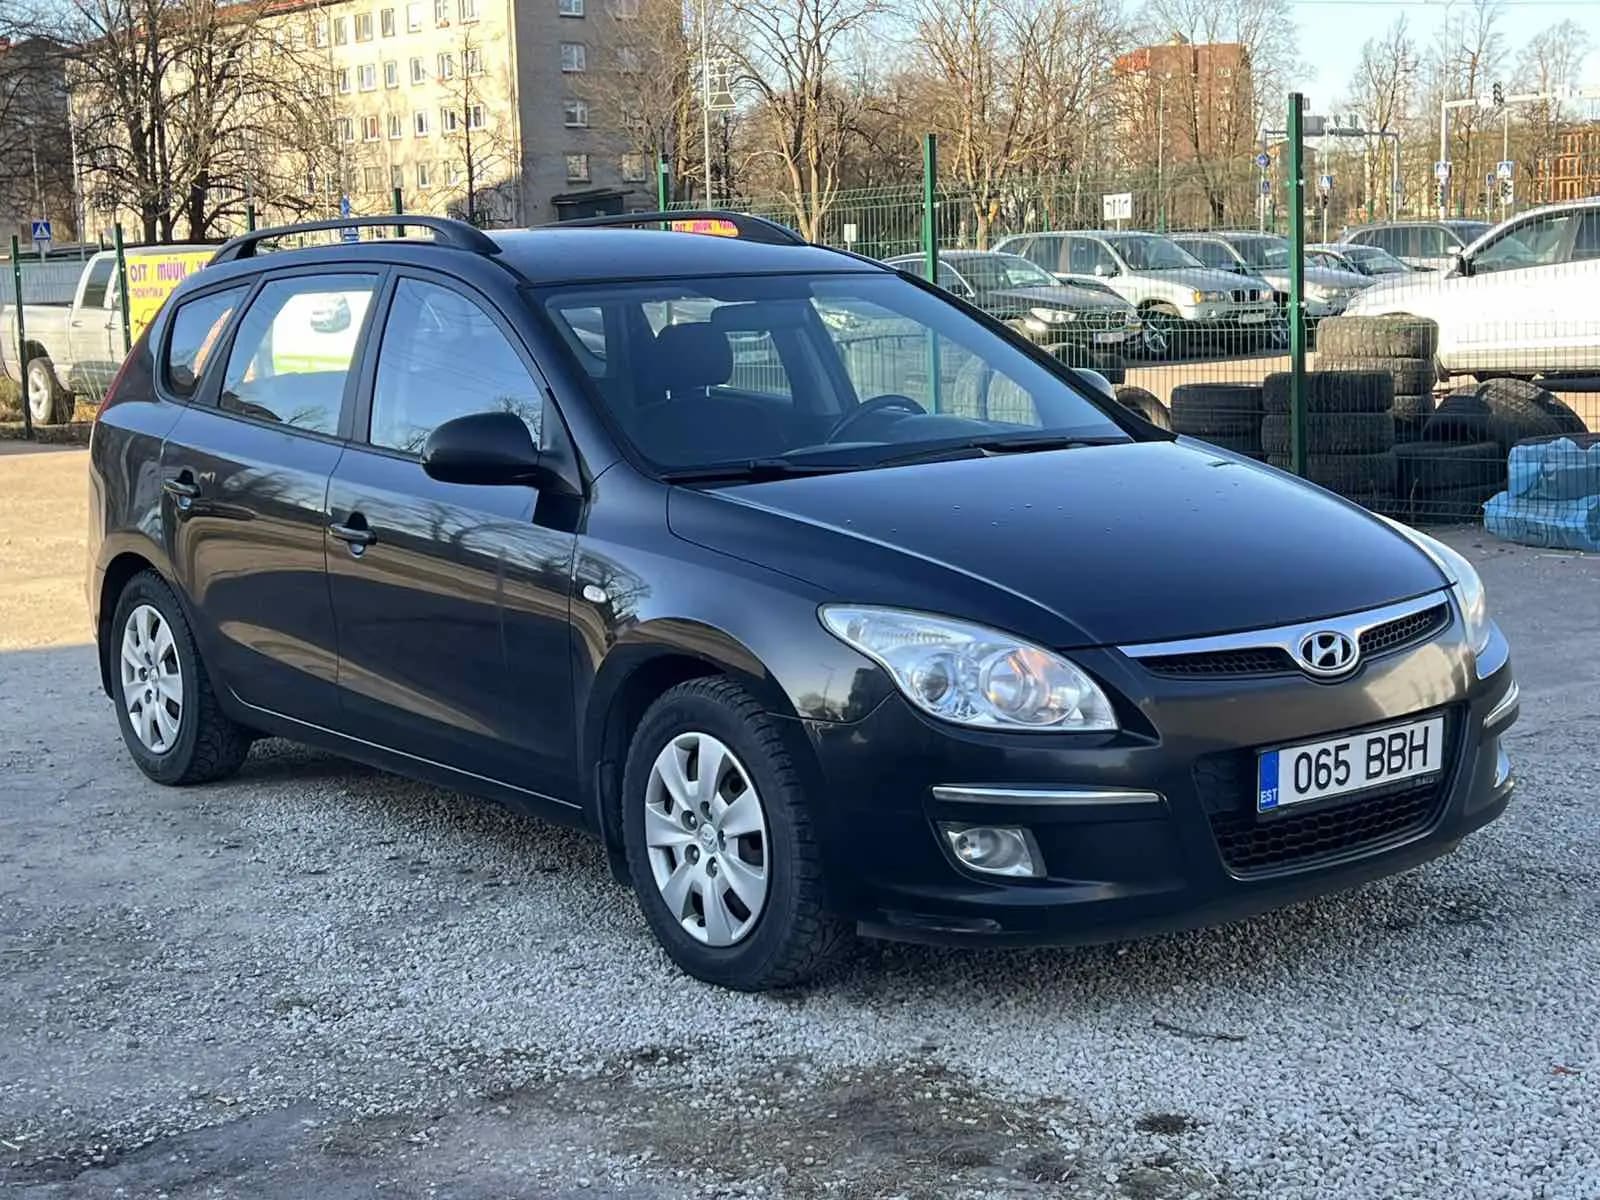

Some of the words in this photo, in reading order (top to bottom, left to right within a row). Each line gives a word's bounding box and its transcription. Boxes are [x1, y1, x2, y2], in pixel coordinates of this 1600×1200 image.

[1295, 744, 1350, 794] 065
[1366, 726, 1429, 780] BBH
[1260, 788, 1278, 803] EST
